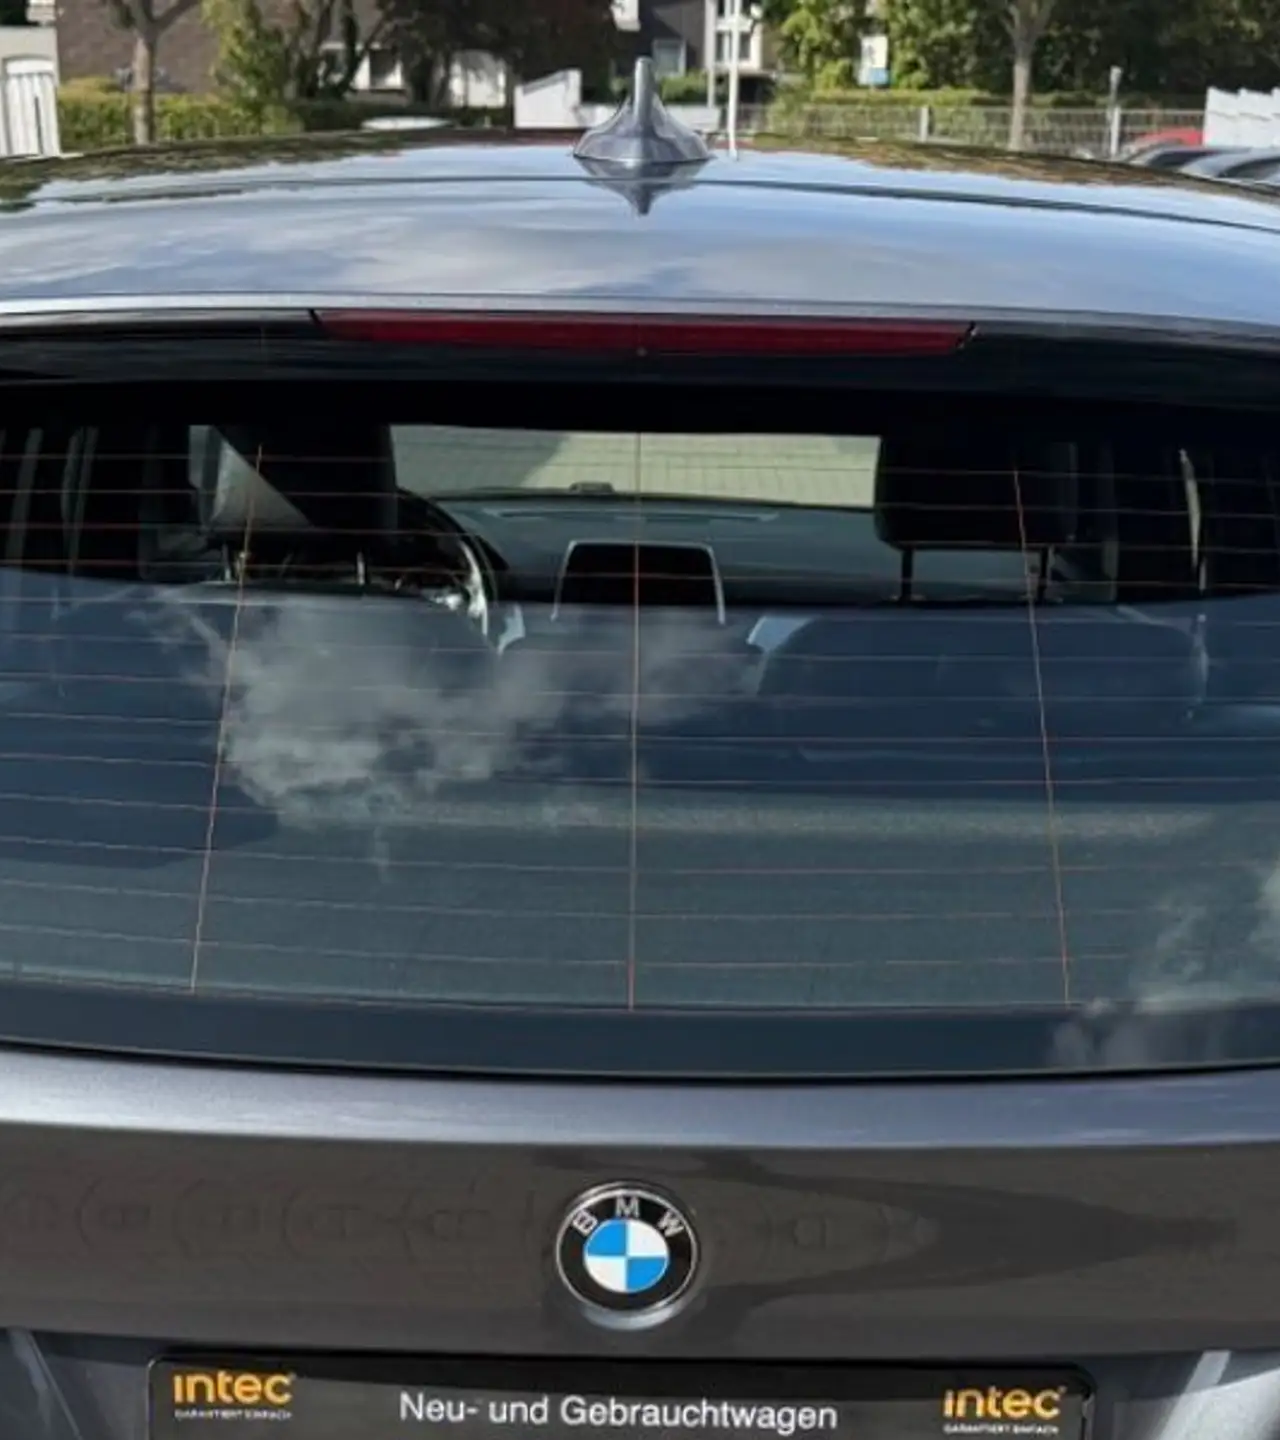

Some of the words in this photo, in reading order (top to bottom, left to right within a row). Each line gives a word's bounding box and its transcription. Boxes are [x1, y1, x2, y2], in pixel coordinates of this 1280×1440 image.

[572, 1193, 685, 1238] BMW
[173, 1371, 293, 1405] intec
[943, 1386, 1062, 1419] intec
[399, 1391, 479, 1423] Neu-
[488, 1395, 550, 1424] und
[559, 1394, 839, 1437] Gebrauchtwagen
